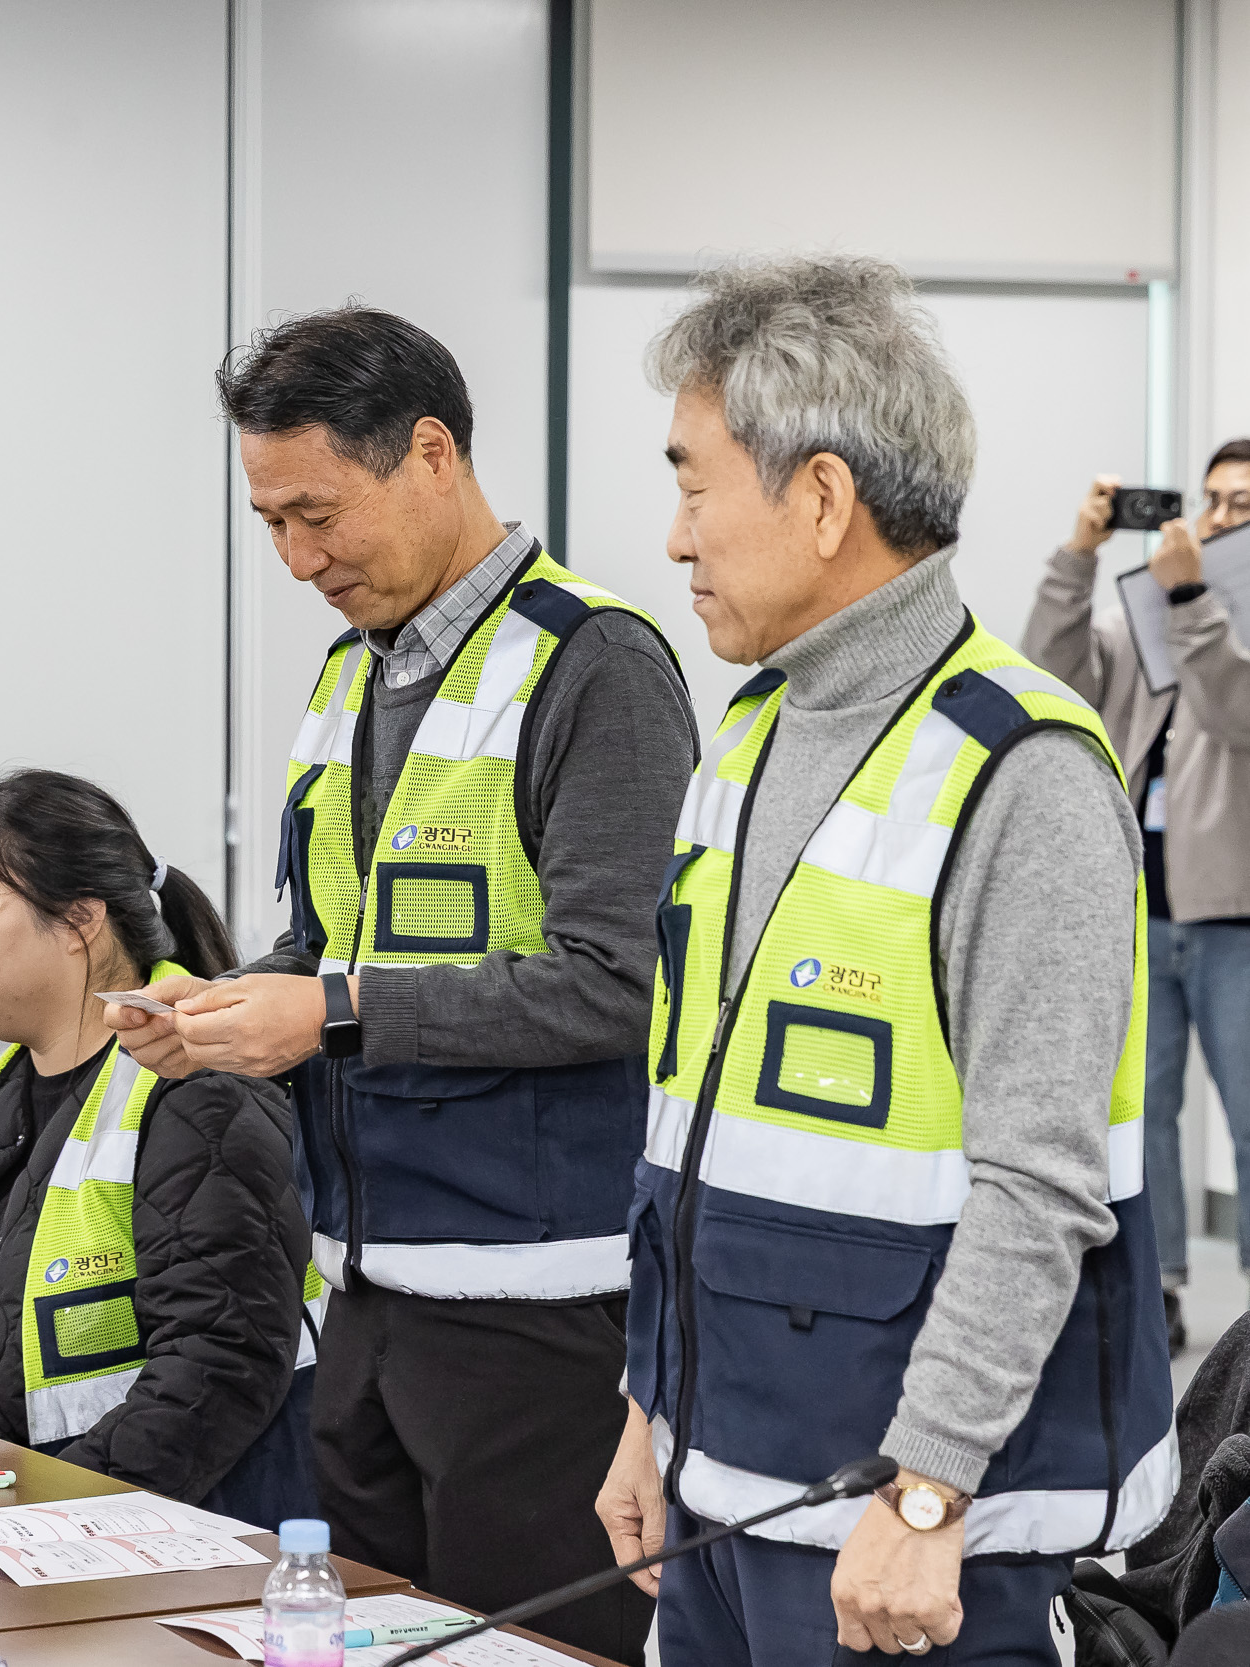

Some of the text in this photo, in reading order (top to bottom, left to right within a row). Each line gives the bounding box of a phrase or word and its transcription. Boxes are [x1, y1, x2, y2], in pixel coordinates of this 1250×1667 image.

[422, 826, 473, 843] 광진구
[419, 842, 473, 852] GWANGJIN-GU
[828, 964, 882, 990] 광진구
[73, 1251, 124, 1271] 광진구
[73, 1265, 126, 1278] GWANGJIN-GU
